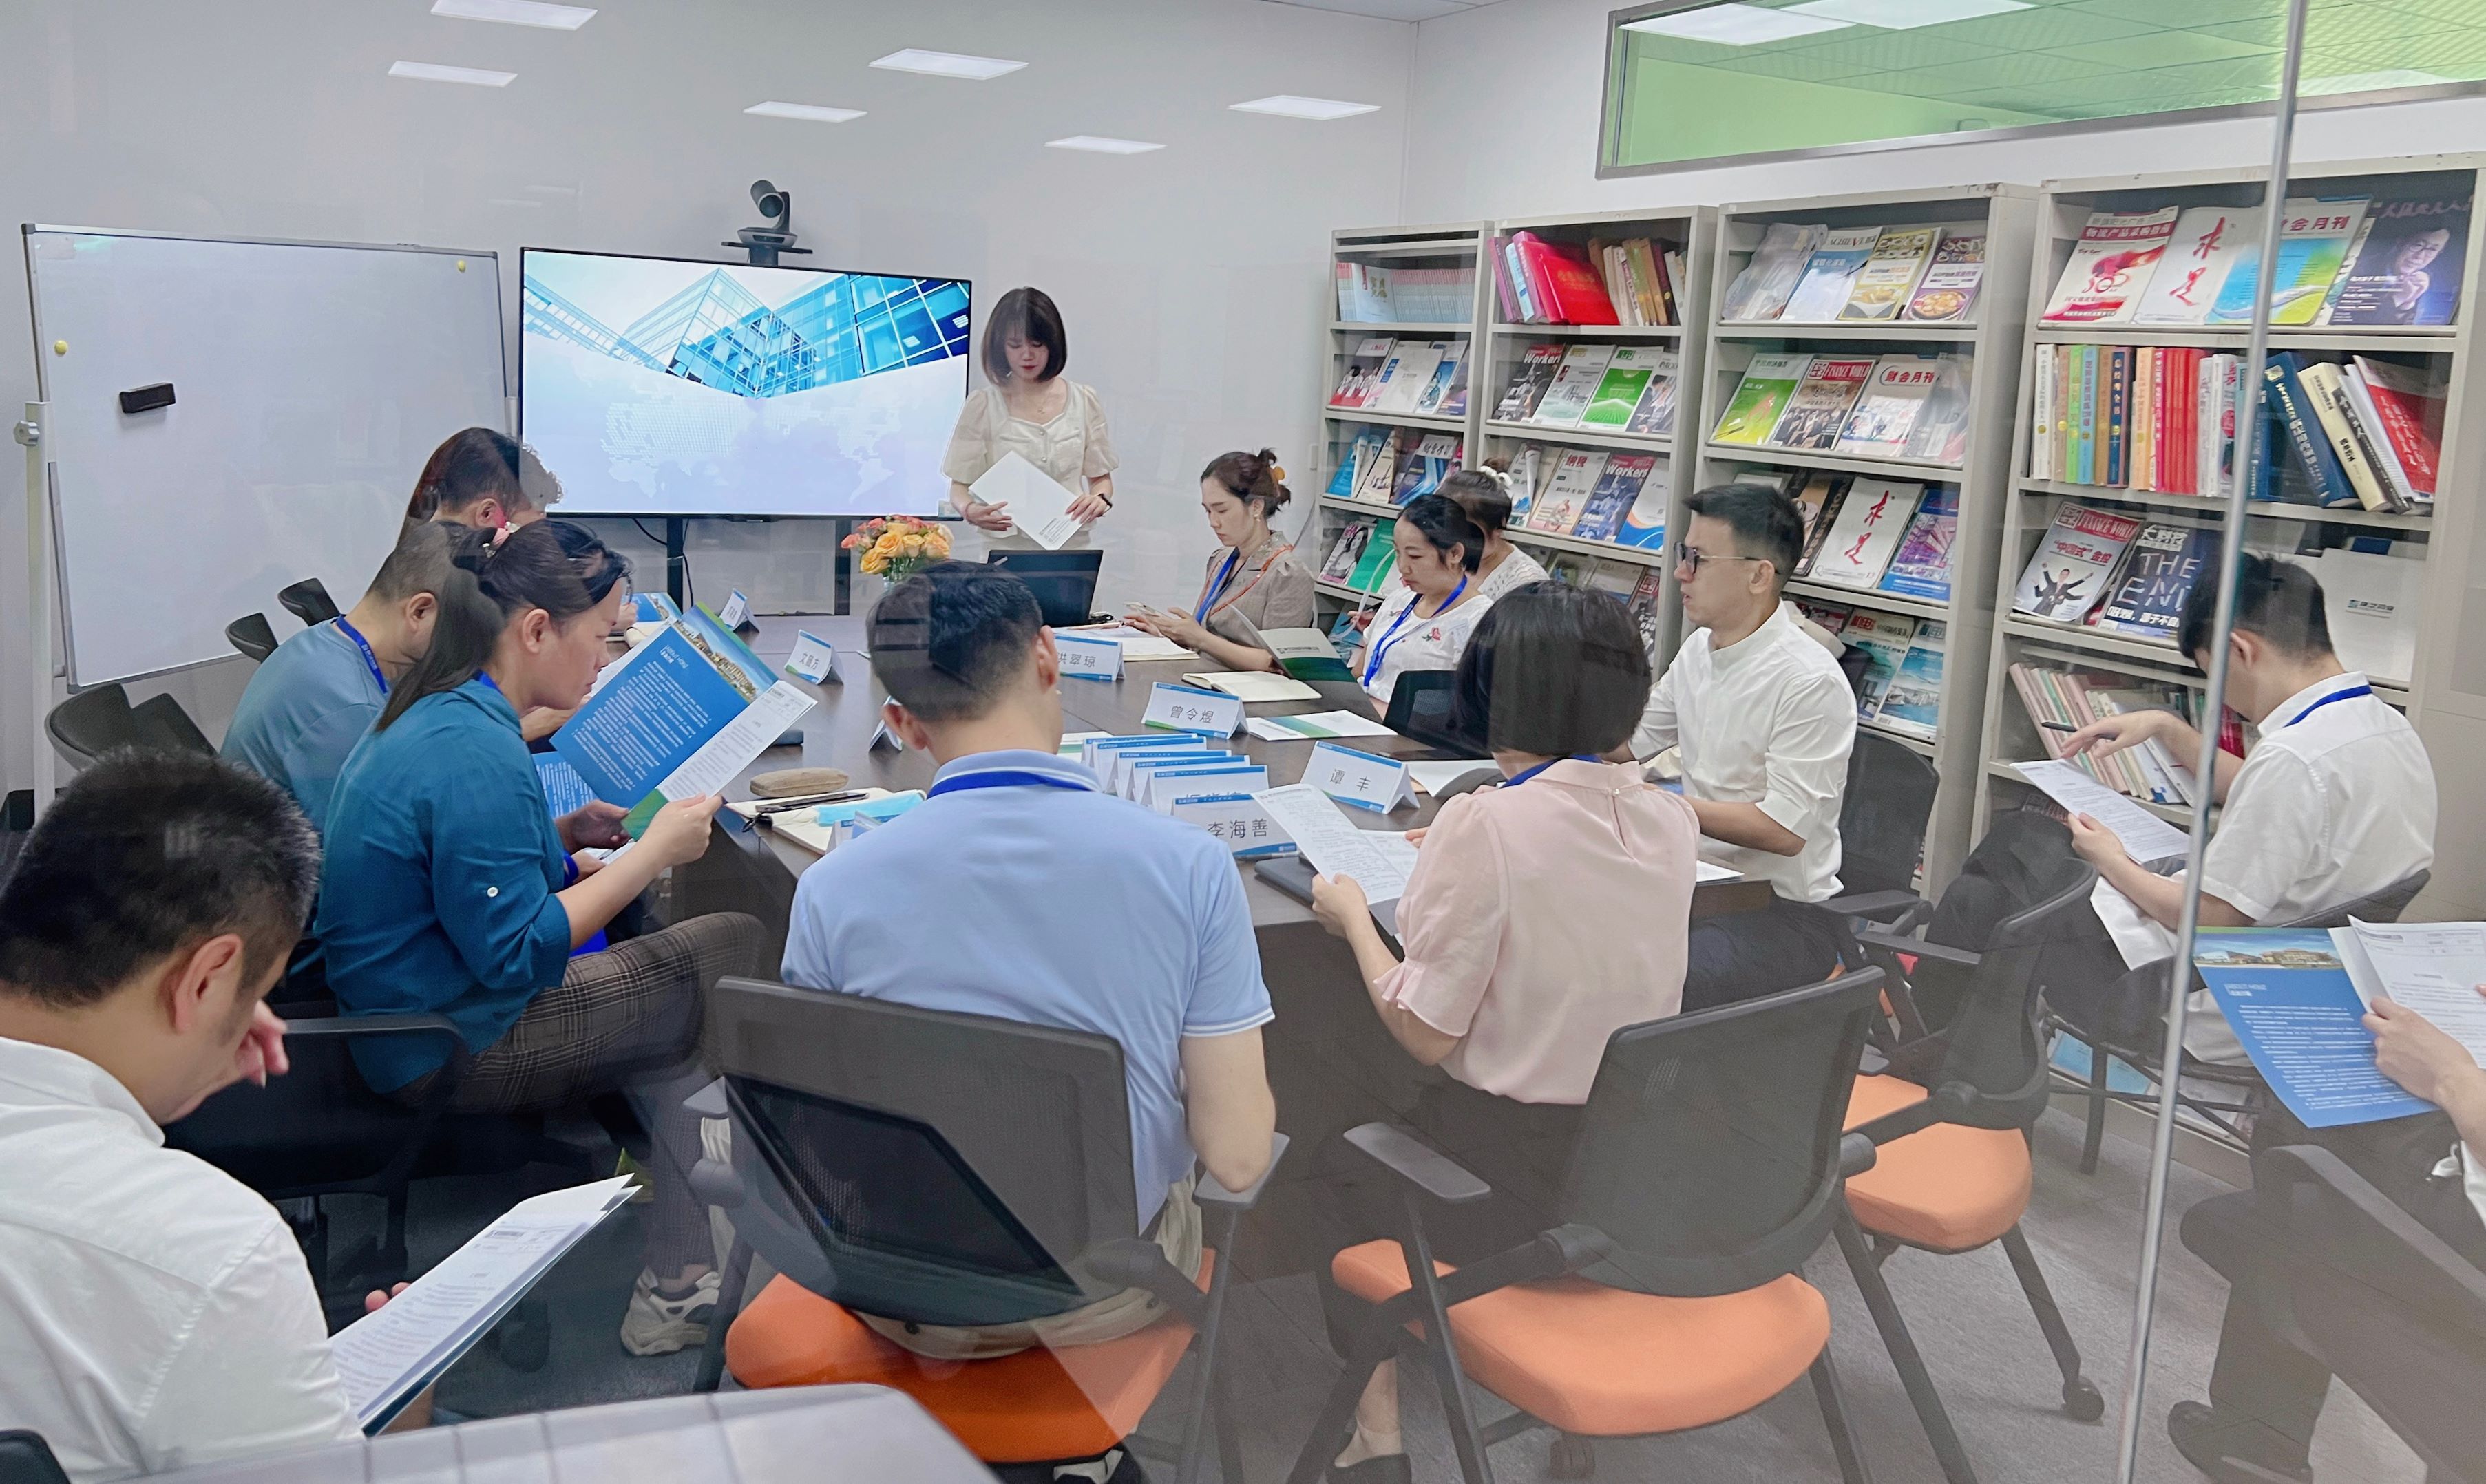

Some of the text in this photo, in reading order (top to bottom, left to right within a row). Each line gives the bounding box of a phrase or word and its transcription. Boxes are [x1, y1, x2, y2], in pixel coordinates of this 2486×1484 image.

[2280, 215, 2350, 232] 会月刊
[1884, 369, 1935, 384] 财会月刊
[1605, 463, 1649, 478] Workers
[2139, 552, 2201, 579] THE
[1170, 705, 1214, 723] 曾令煜
[1329, 768, 1371, 792] 谭丰
[1208, 818, 1268, 838] 李海善
